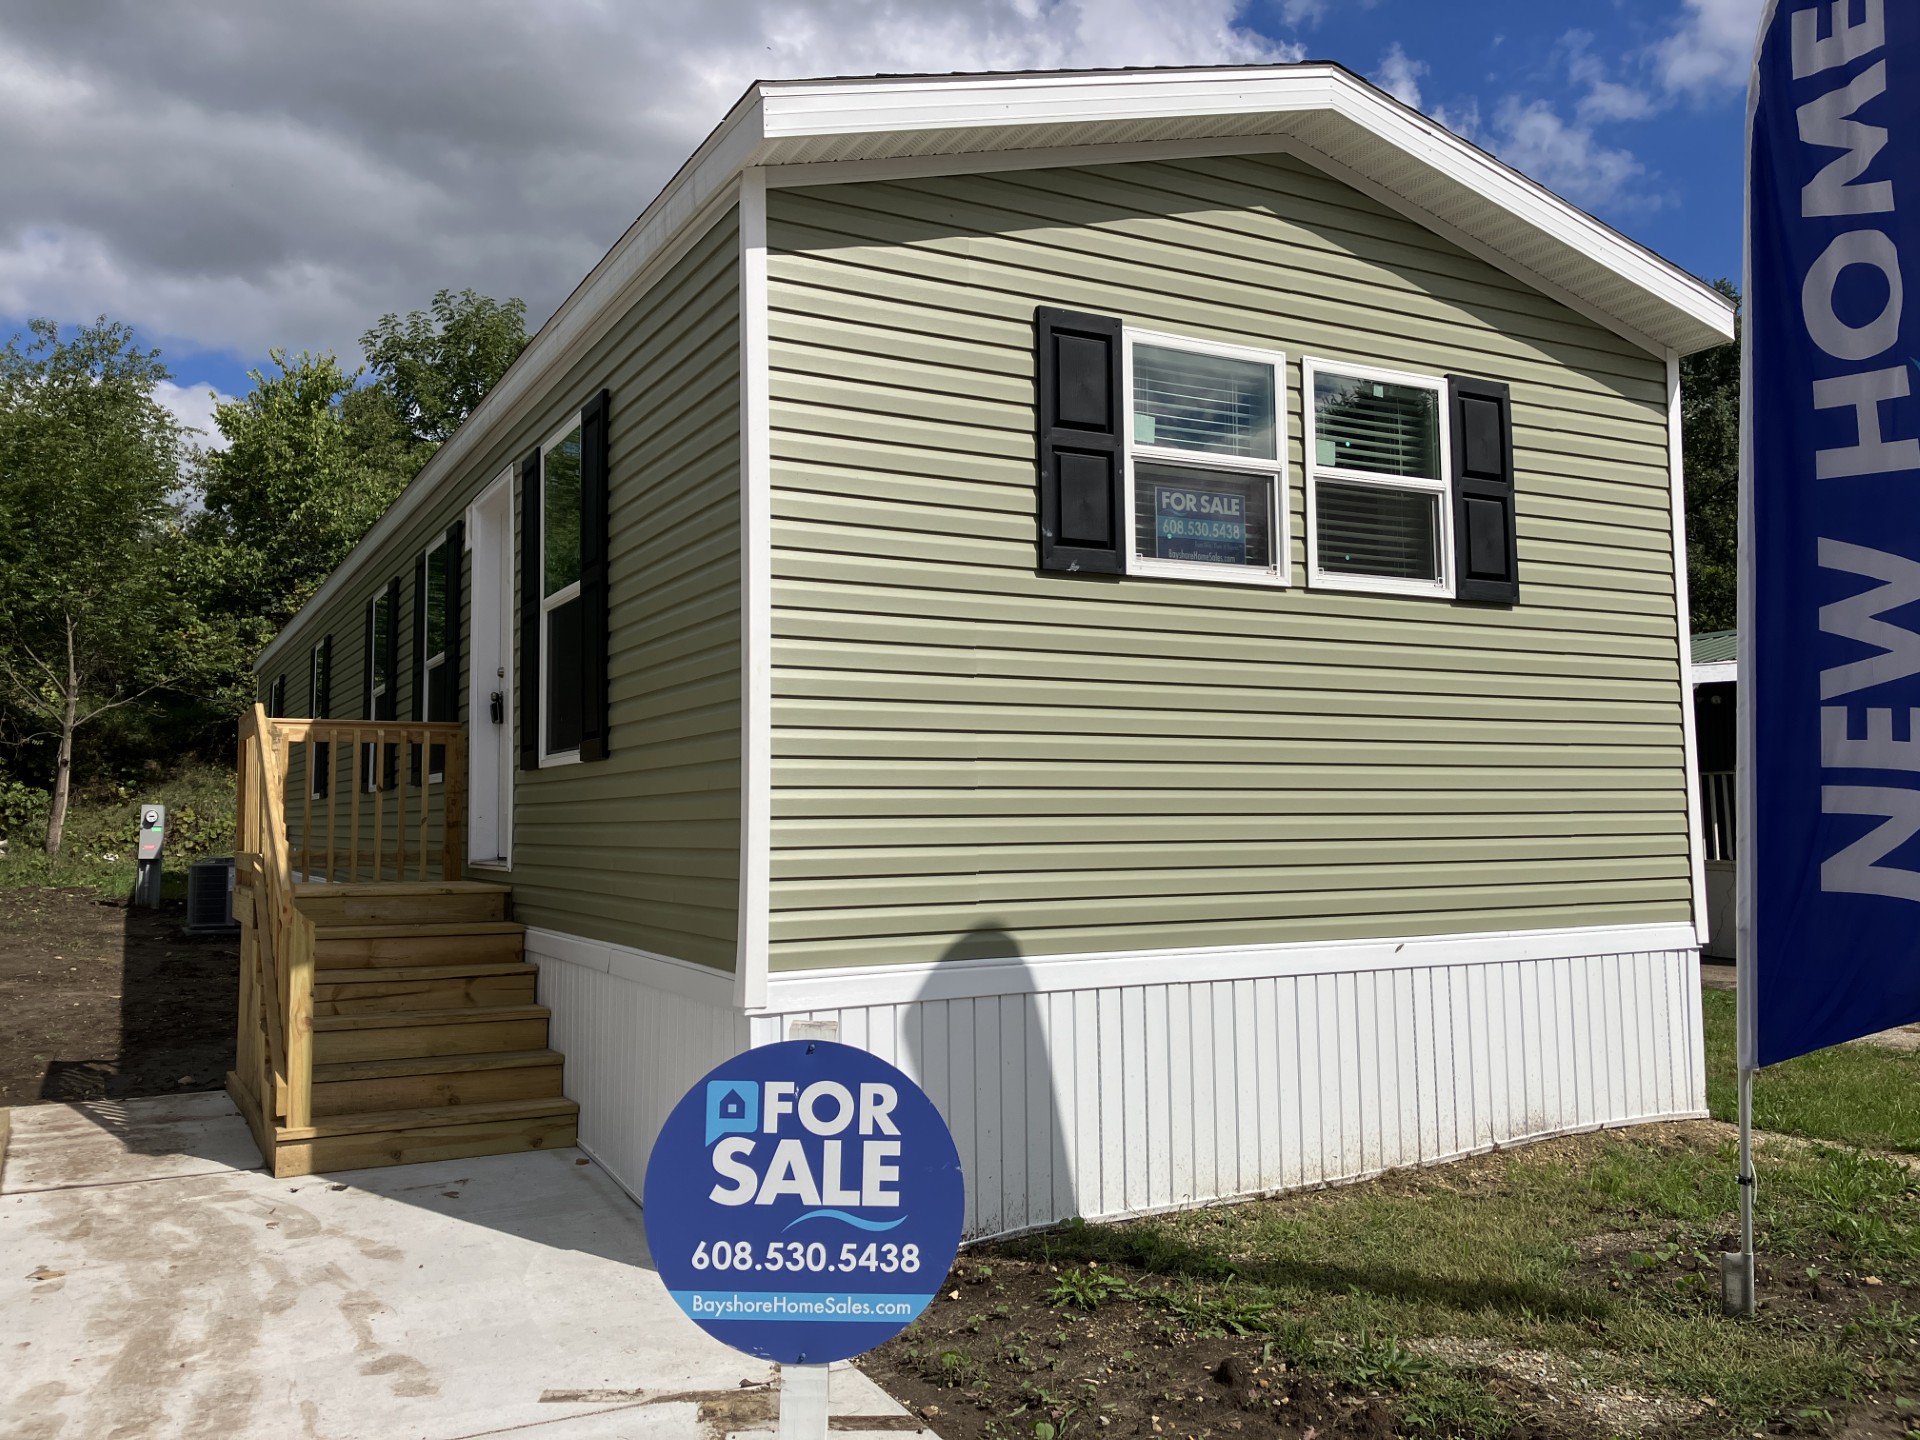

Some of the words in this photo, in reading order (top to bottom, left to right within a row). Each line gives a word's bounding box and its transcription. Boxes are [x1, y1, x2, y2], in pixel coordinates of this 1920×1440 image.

[1791, 0, 1920, 480] HOME
[1161, 491, 1197, 512] FOR
[1200, 495, 1240, 516] SALE
[1163, 519, 1240, 540] 608.530.5438
[1168, 549, 1236, 563] BayshoreHomeSales.com
[1818, 536, 1920, 902] NEW
[763, 1080, 902, 1136] FOR
[708, 1136, 901, 1207] SALE
[691, 1241, 920, 1273] 608.530.5438
[692, 1294, 911, 1317] BayshoreHomeSales.com
